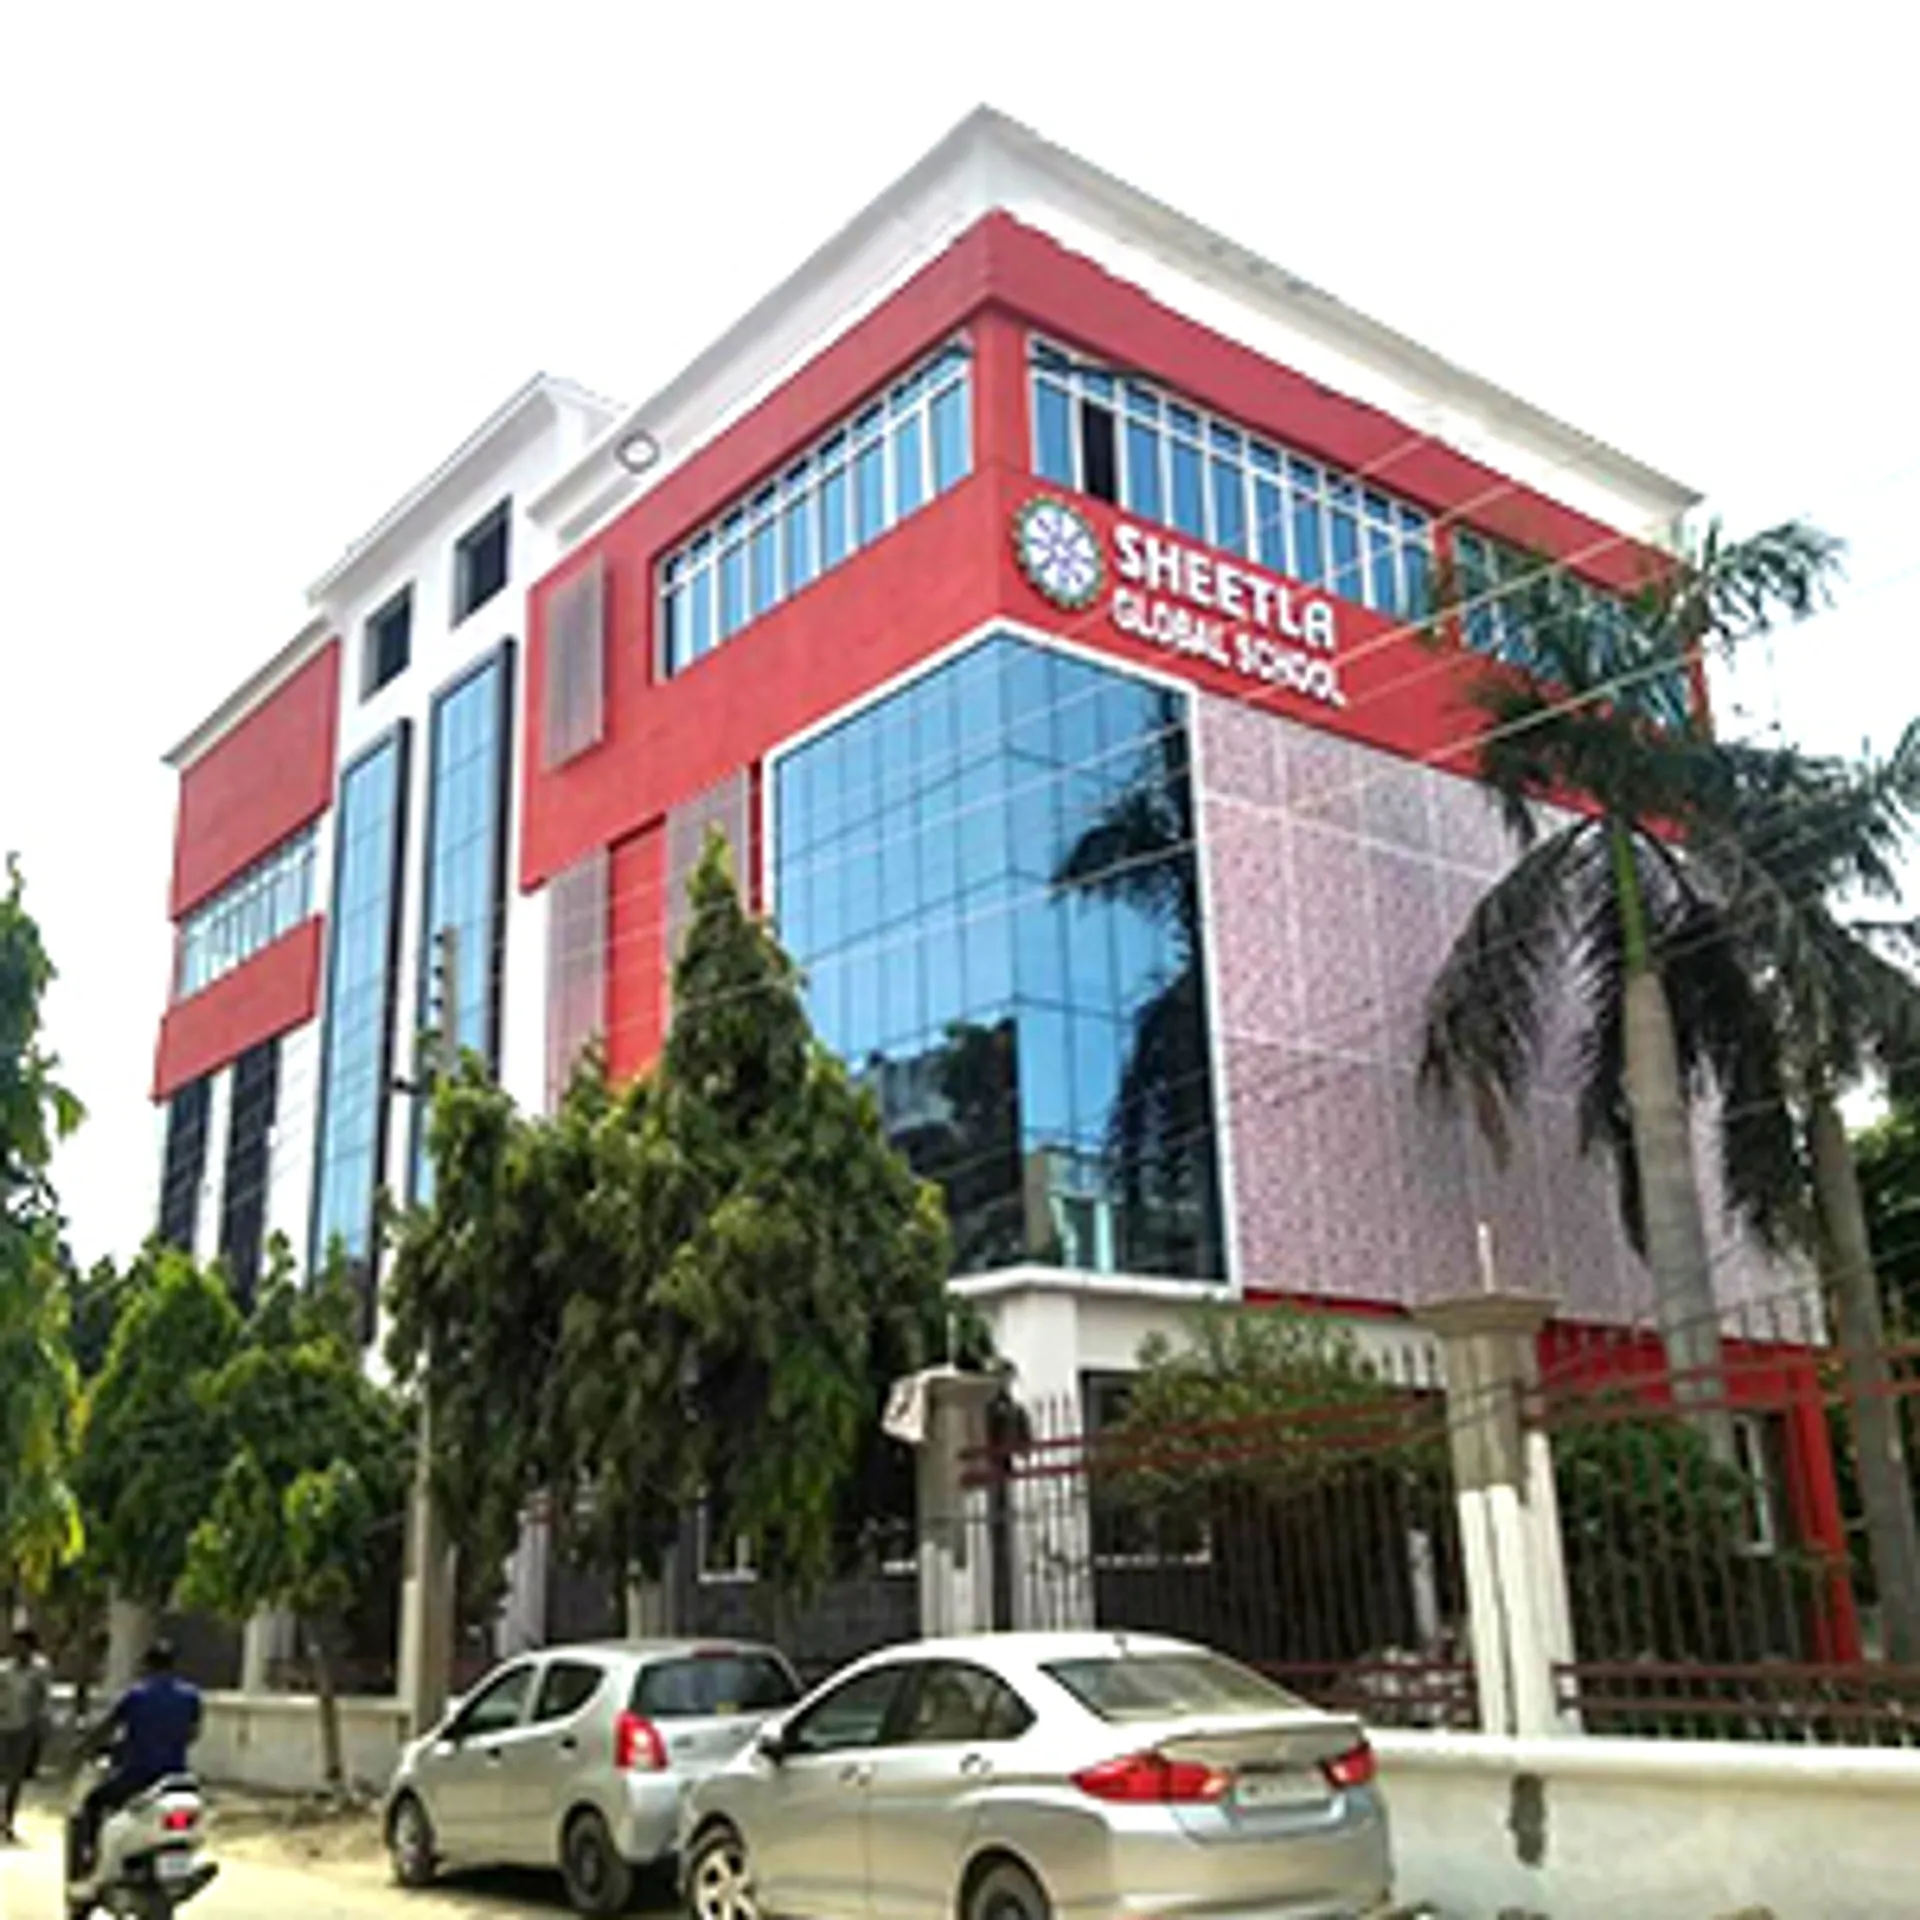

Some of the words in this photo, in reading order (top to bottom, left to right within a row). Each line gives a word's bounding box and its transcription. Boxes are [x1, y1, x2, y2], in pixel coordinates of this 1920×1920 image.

[1112, 587, 1231, 667] GLOBAL
[1234, 632, 1346, 706] SCHOOL
[1113, 523, 1336, 649] SHEETLA
